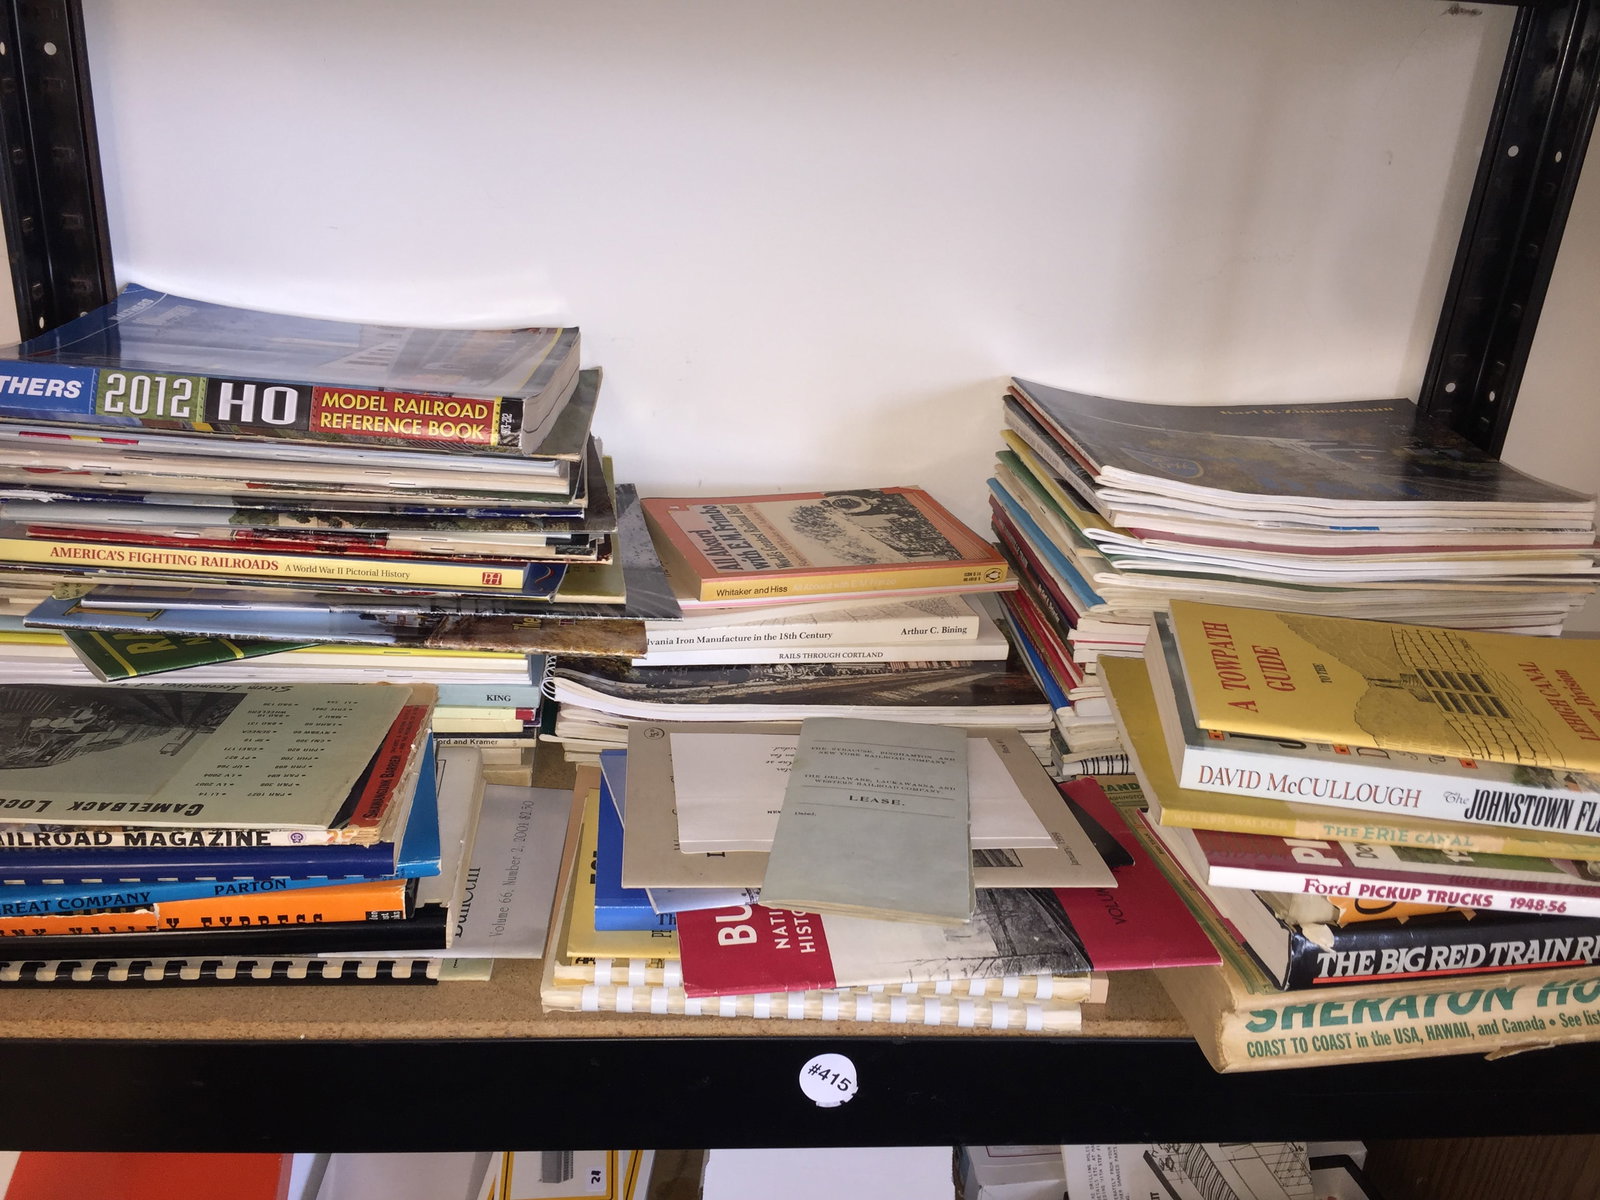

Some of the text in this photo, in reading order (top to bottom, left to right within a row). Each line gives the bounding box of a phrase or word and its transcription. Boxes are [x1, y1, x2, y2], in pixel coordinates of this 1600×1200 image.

[103, 373, 193, 418] 2012
[218, 382, 299, 426] HO
[321, 392, 488, 420] MODEL RAILROAD
[320, 412, 422, 435] REFERENCE
[428, 421, 486, 440] BOOK
[50, 546, 411, 580] AMERICA'S FIGHTING RAILROADS A World War II Pictorial History
[688, 529, 744, 571] All Aboard
[716, 587, 752, 597] Whitaker
[754, 586, 769, 594] and
[770, 585, 788, 593] Hiss
[676, 635, 695, 645] Iron
[697, 633, 752, 644] Manufacture
[753, 633, 763, 641] in
[763, 632, 778, 641] the
[779, 632, 798, 640] 18th
[799, 631, 834, 641] Century
[901, 626, 928, 636] Arthur
[929, 626, 940, 635] C.
[941, 625, 968, 635] Bining
[1202, 621, 1259, 713] A TOWPATH
[1251, 645, 1297, 692] GUIDE
[486, 694, 511, 702] KING
[1518, 661, 1600, 741] LEHIGH CANAL
[1555, 669, 1596, 708] Division
[453, 738, 468, 746] and
[469, 738, 499, 746] Kramer
[66, 801, 205, 816] CAMELBACK
[849, 795, 906, 806] LEASE.
[1198, 765, 1261, 790] DAVID
[1267, 773, 1422, 809] McCULLOUGH
[1443, 791, 1470, 805] The
[1464, 788, 1575, 830] JOHNSTOWN
[124, 831, 271, 846] MAGAZINE
[513, 822, 530, 842] 2001
[1323, 824, 1359, 837] THE
[1363, 826, 1409, 843] ERIE
[502, 856, 521, 886] Number
[0, 879, 287, 915] REAT COMPANY PARTON
[499, 889, 515, 904] 66,
[1303, 878, 1352, 896] Ford
[1358, 883, 1422, 900] PICKUP
[1427, 889, 1494, 907] TRUCKS
[489, 907, 510, 937] Volume
[1316, 950, 1376, 978] THE
[1377, 945, 1428, 974] BIG
[1426, 943, 1486, 971] RED
[1489, 937, 1575, 967] TRAIN
[1246, 1038, 1287, 1058] COAST
[1290, 1036, 1309, 1053] TO
[1312, 1032, 1352, 1052] COAST
[1356, 1032, 1369, 1048] in
[1371, 1029, 1392, 1047] the
[1393, 1026, 1424, 1045] USA,
[1425, 1021, 1475, 1041] HAWAII,
[1478, 1018, 1500, 1037] and
[1502, 1015, 1546, 1033] Canada
[1559, 1011, 1581, 1028] See
[807, 1063, 852, 1092] #415
